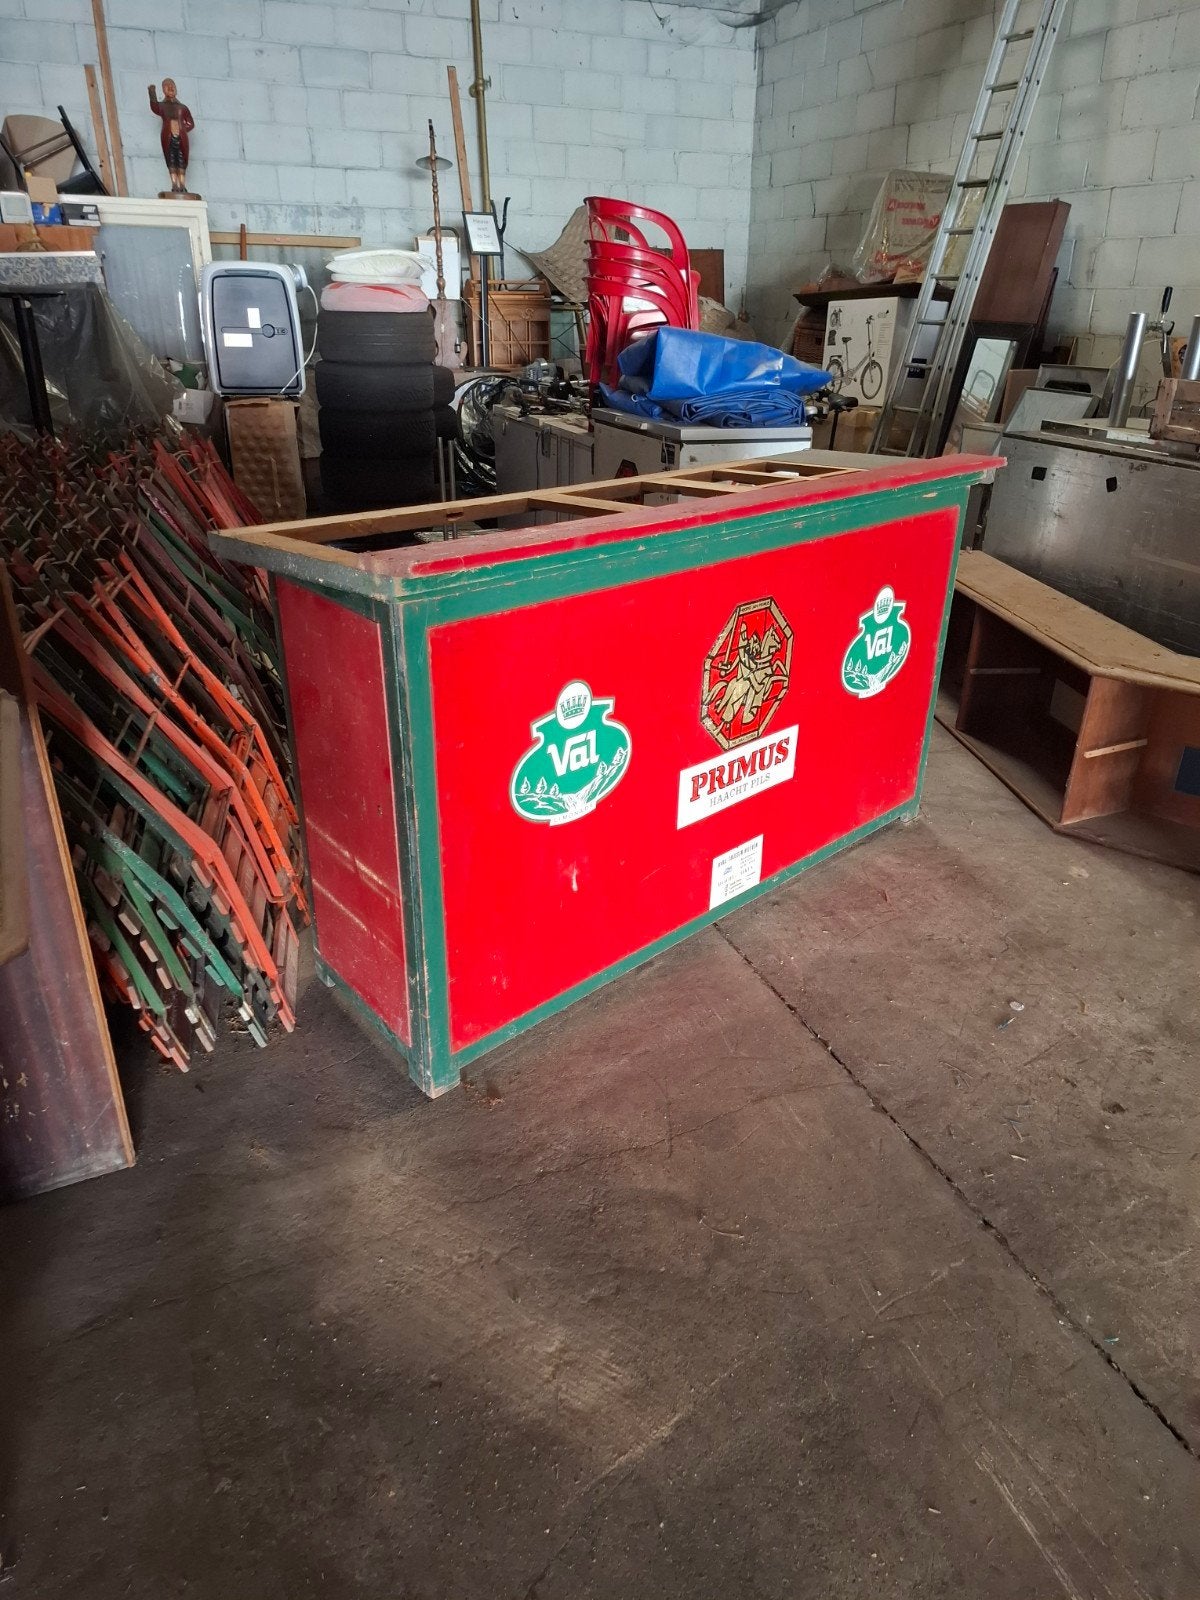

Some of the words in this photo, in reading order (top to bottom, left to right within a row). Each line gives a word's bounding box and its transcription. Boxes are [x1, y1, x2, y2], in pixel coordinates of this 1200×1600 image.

[865, 626, 893, 660] Val
[547, 730, 600, 777] Val
[690, 736, 790, 802] PRIMUS
[709, 782, 748, 807] HAACHT
[751, 772, 771, 789] PILS
